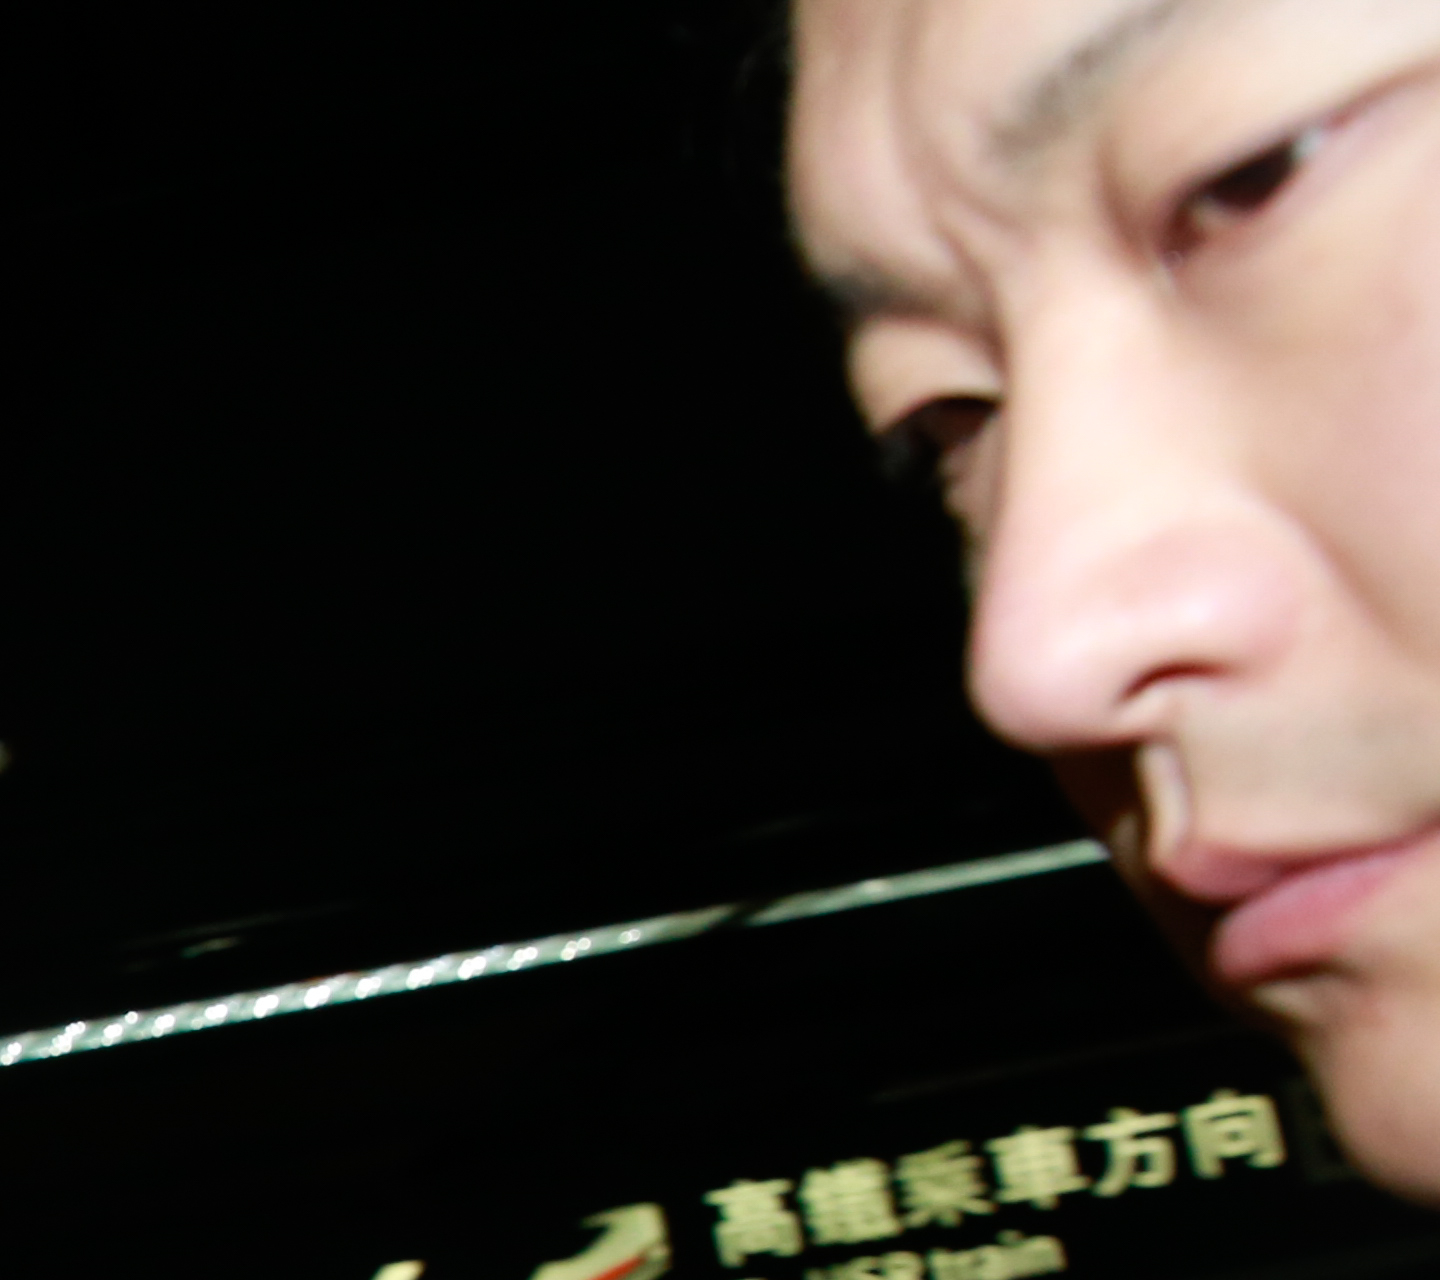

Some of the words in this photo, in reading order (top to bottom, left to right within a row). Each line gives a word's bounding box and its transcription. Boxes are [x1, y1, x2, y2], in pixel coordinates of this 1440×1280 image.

[701, 1087, 1288, 1270] 高鐵乘車方向
